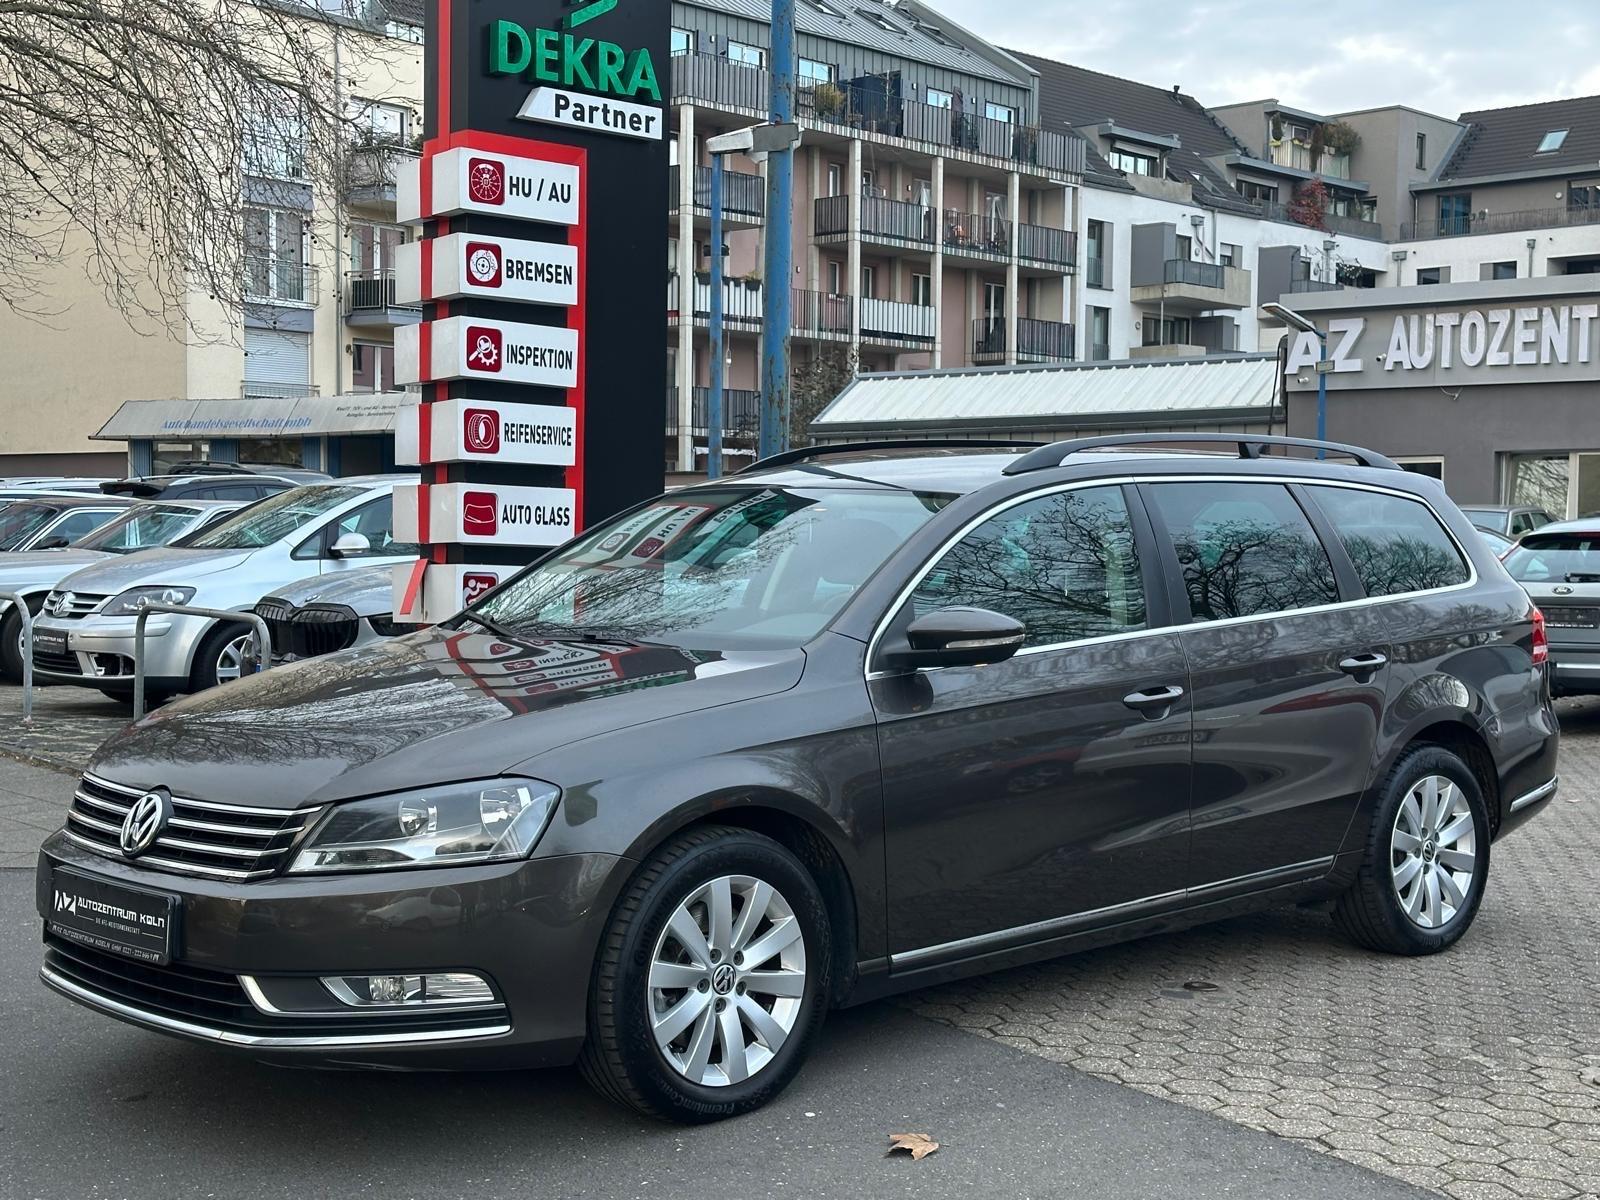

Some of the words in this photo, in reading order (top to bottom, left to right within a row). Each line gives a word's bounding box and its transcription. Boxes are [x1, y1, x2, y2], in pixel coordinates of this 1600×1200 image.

[490, 19, 662, 101] DEKRA
[554, 94, 656, 134] Partner
[508, 175, 532, 198] HU
[536, 178, 545, 201] /
[548, 182, 571, 204] AU
[505, 258, 573, 285] BREMSEN
[1284, 317, 1367, 374] AZ
[1384, 304, 1599, 371] AUTOZENT
[506, 344, 573, 370] INSPEKTION
[504, 422, 572, 446] REIFENSERVICE
[502, 504, 531, 525] AUTO
[535, 506, 570, 526] GLASS
[77, 896, 137, 922] AUTOZENTRUM
